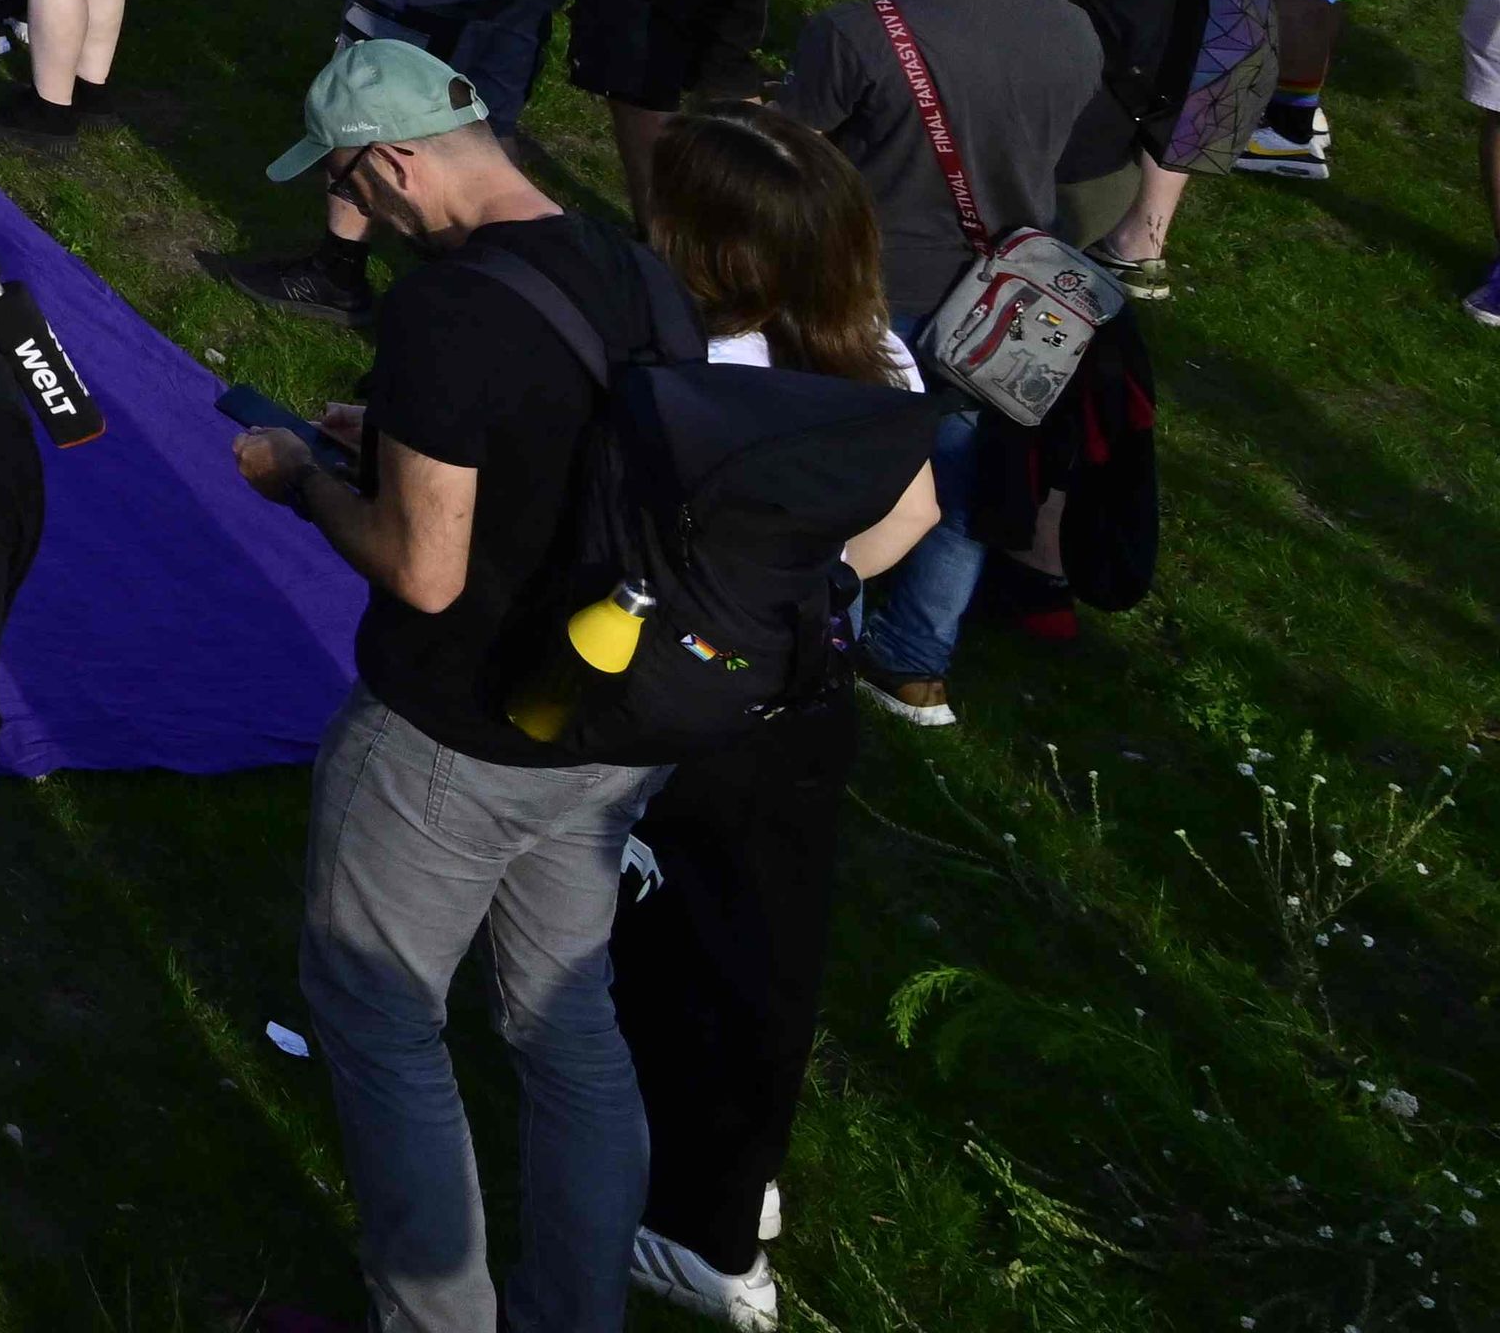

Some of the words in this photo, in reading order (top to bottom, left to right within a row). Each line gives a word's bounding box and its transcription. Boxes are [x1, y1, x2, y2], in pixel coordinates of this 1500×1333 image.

[882, 14, 908, 39] XIV
[895, 41, 934, 109] FANTASY
[925, 109, 954, 154] FINAL
